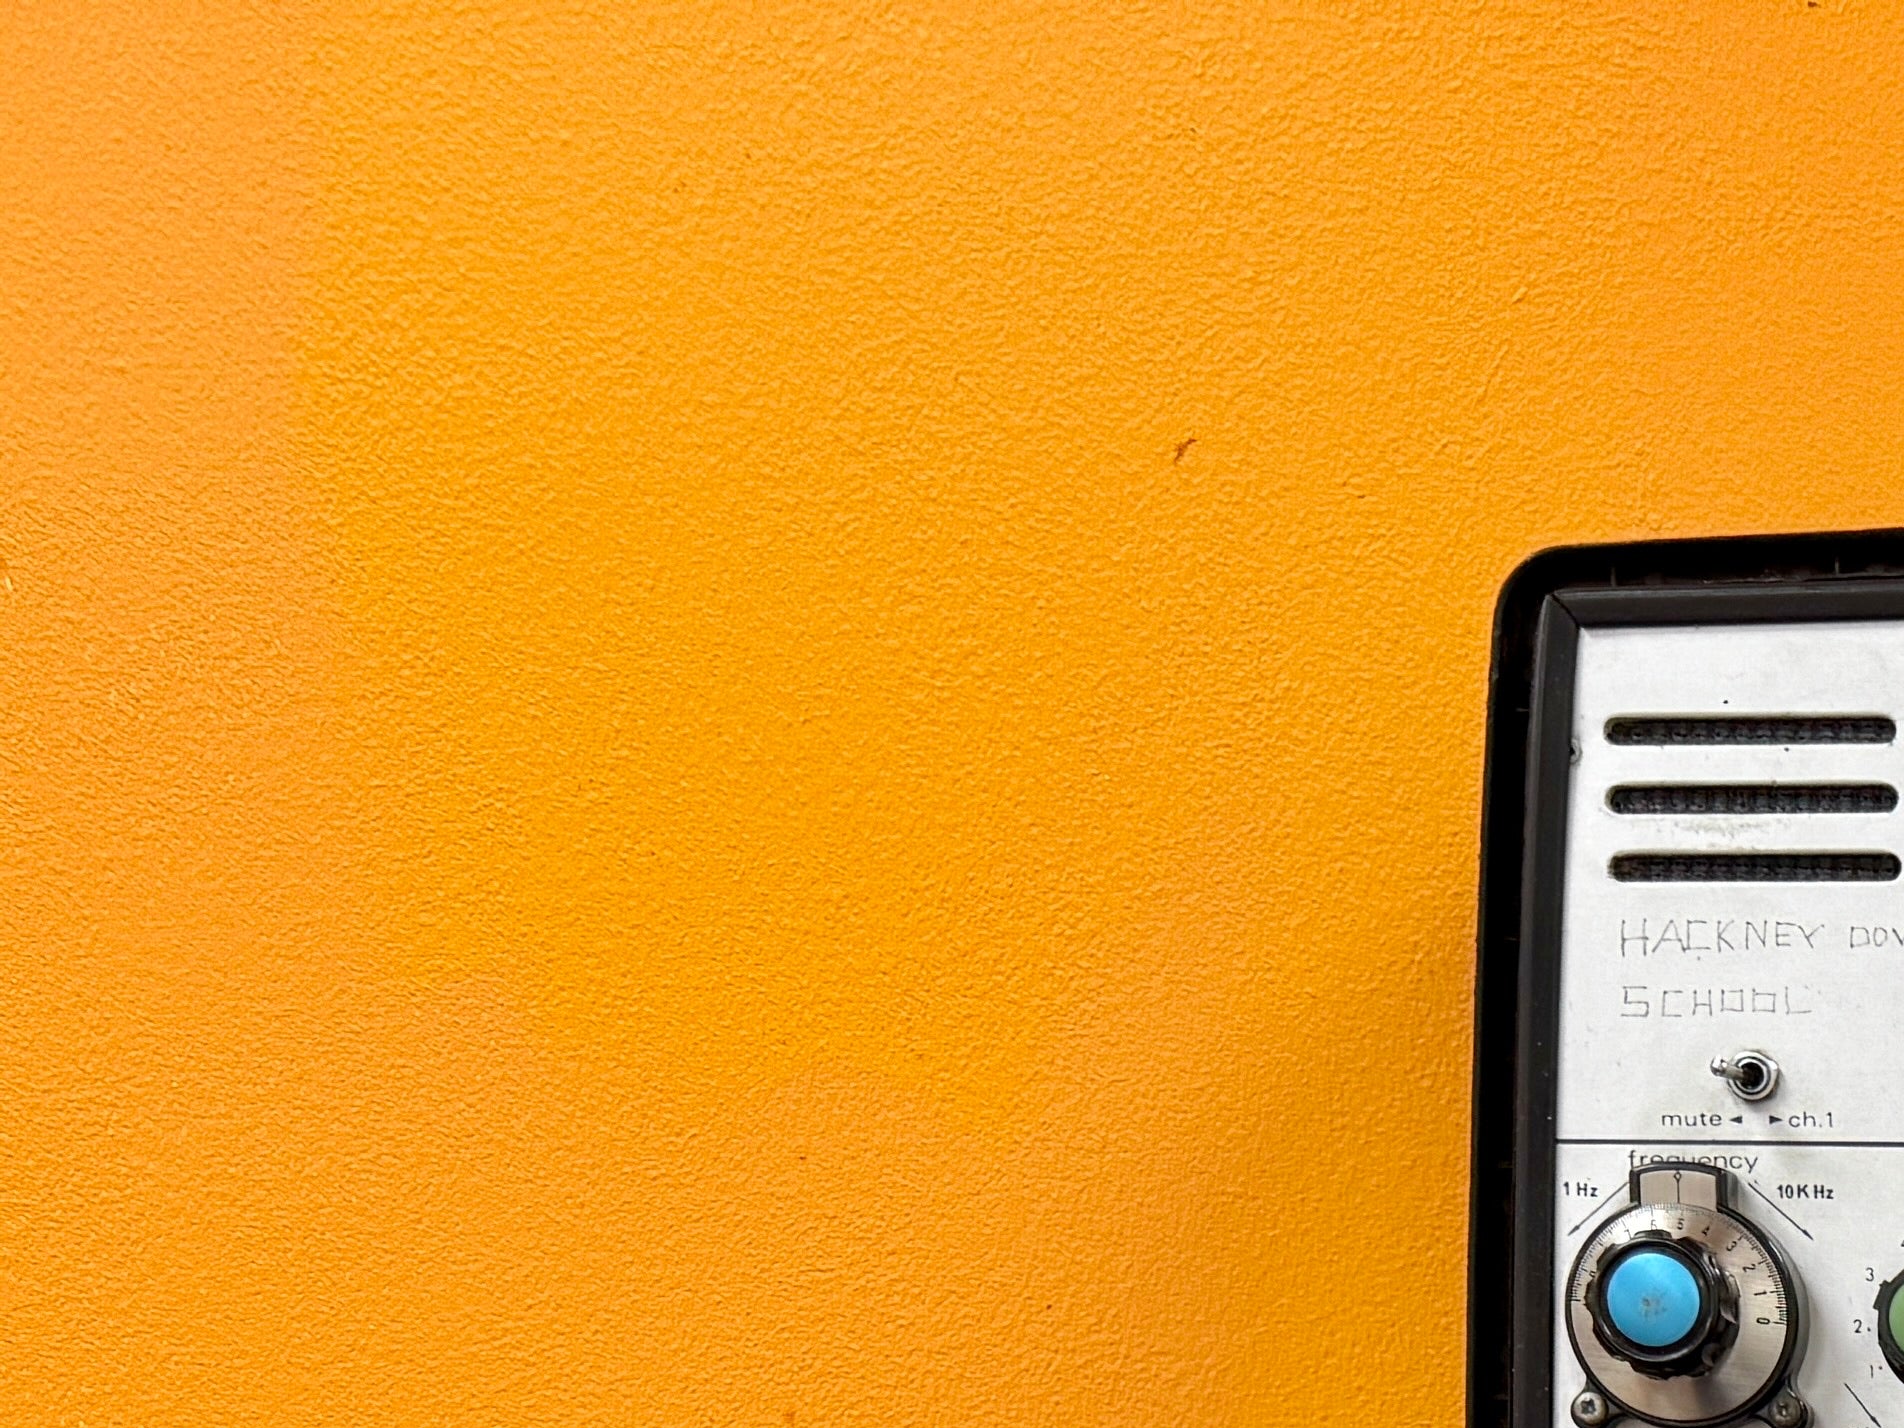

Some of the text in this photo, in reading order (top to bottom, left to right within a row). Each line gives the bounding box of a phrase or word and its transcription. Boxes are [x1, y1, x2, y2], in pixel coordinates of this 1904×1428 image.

[1621, 919, 1824, 957] HACKNEY
[1621, 986, 1812, 1017] SCHOOL
[1662, 1113, 1721, 1126] mute
[1789, 1112, 1832, 1127] ch.1
